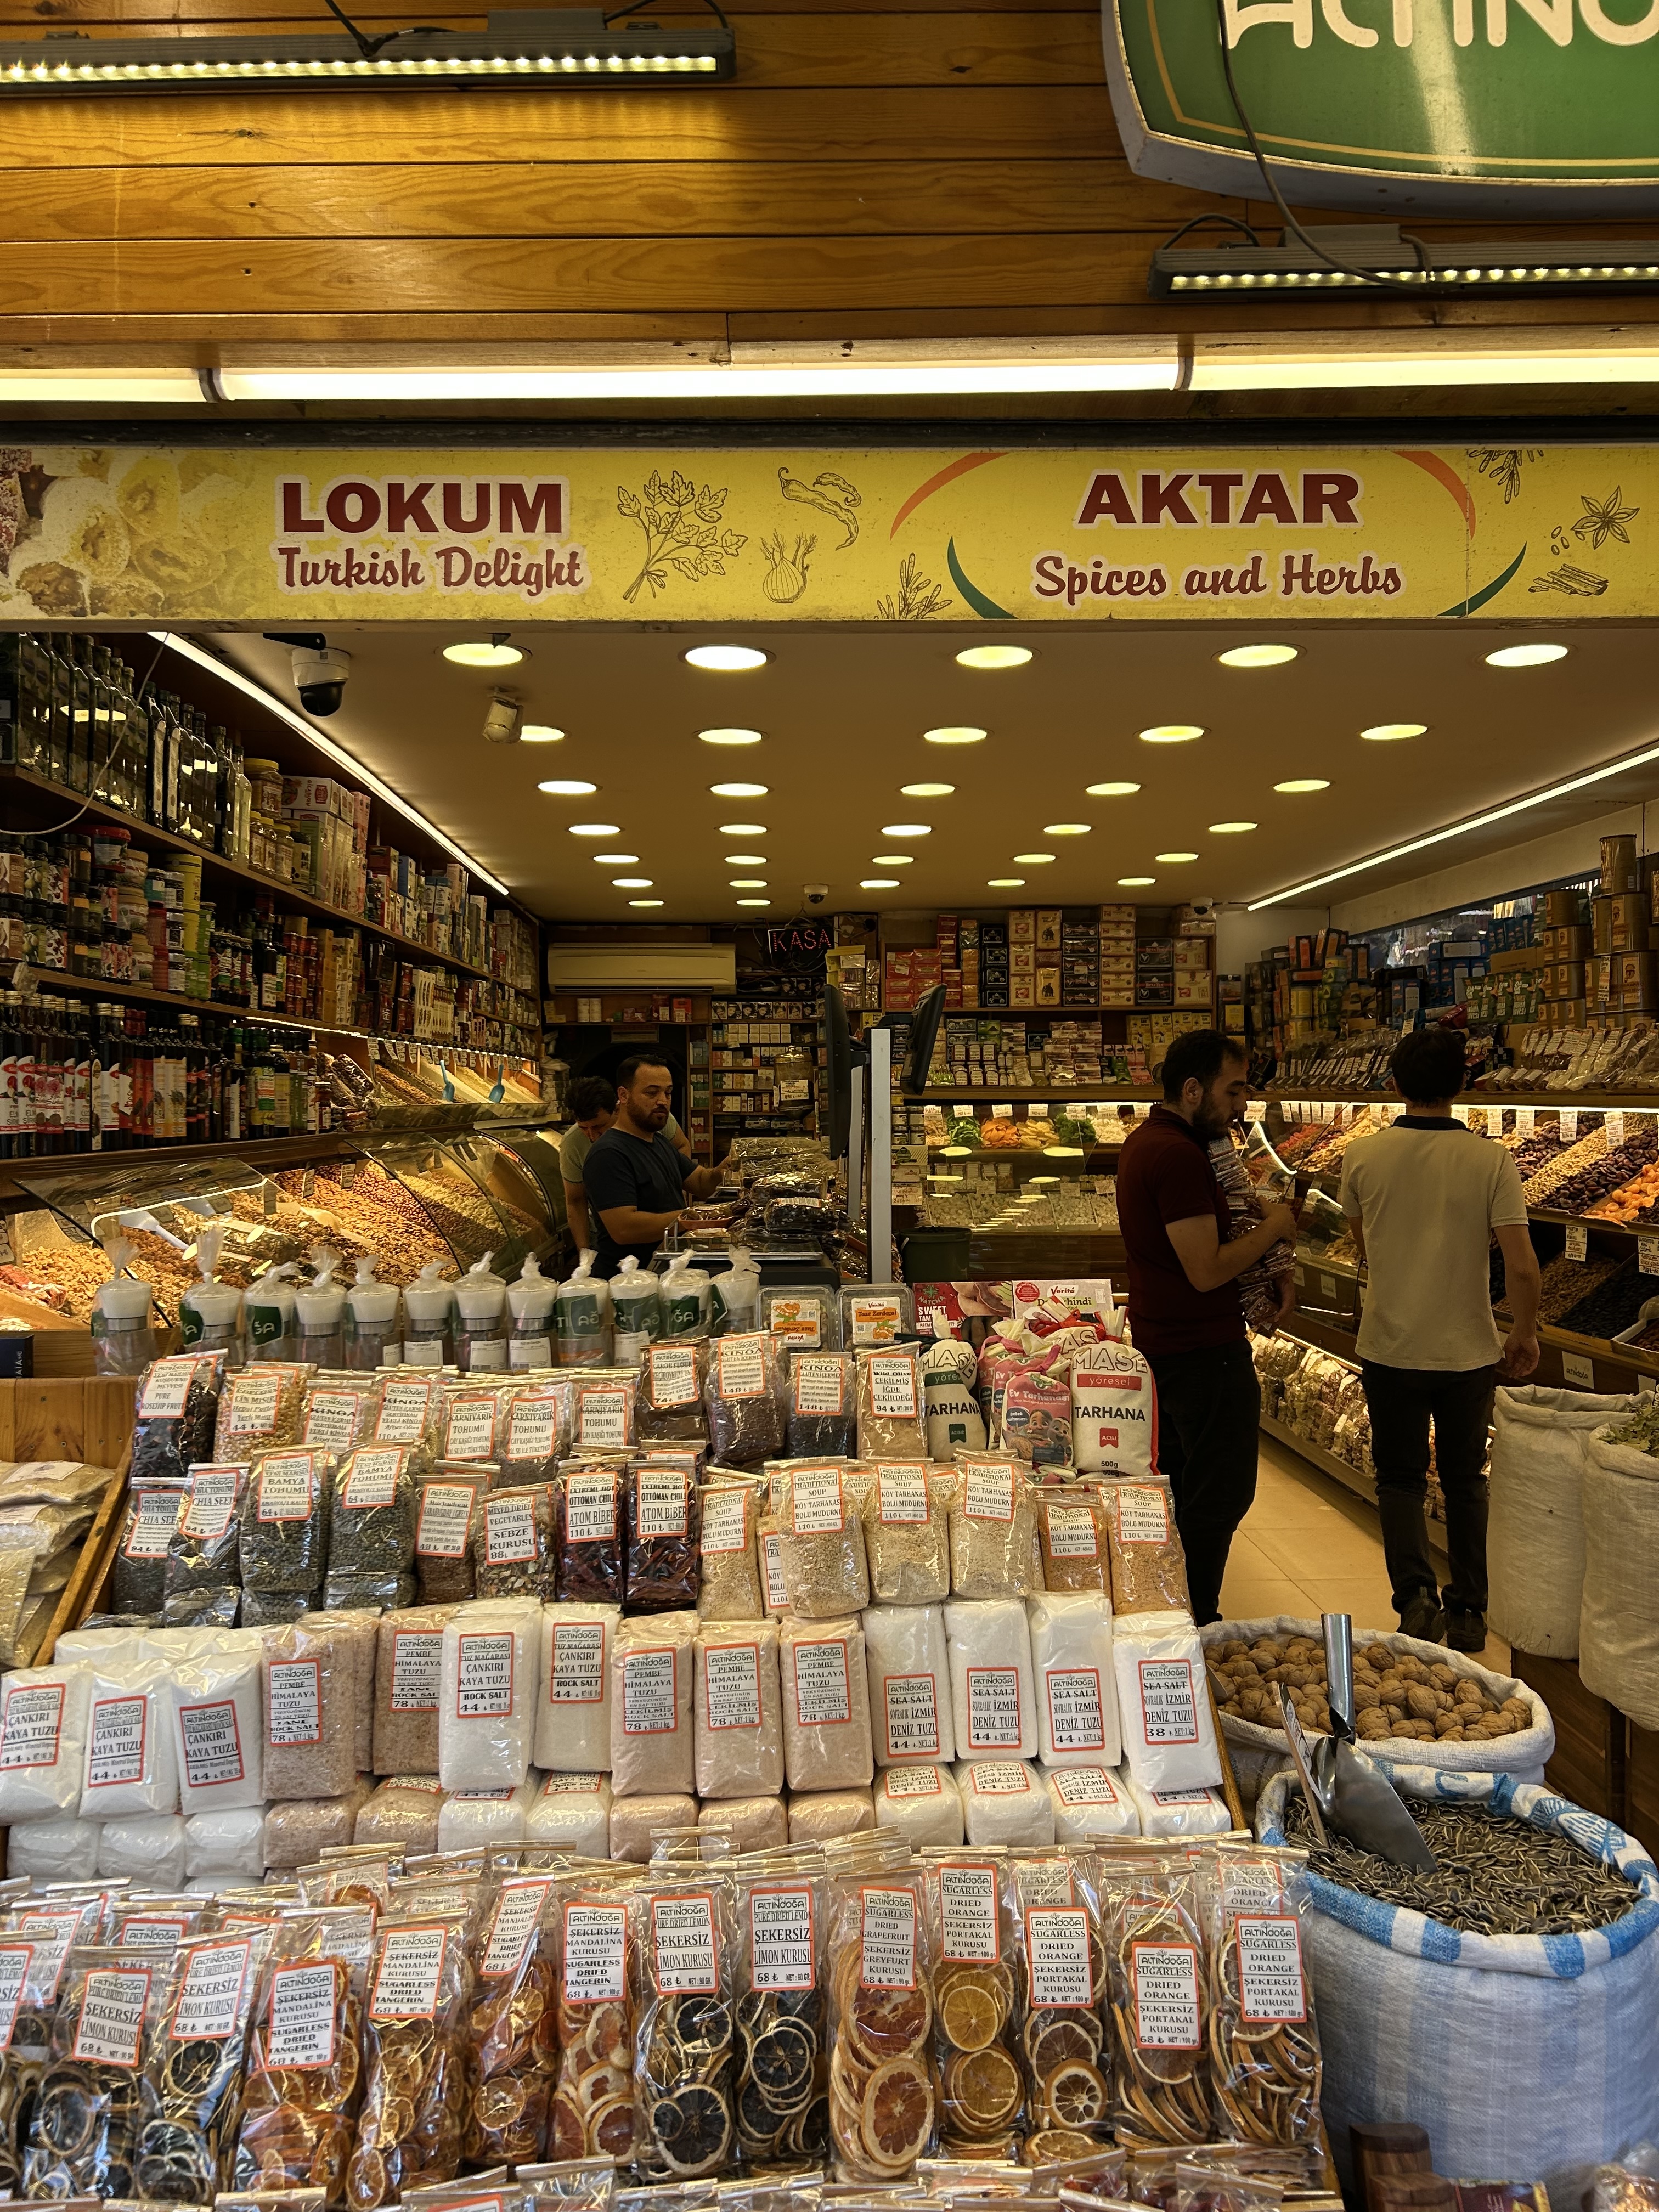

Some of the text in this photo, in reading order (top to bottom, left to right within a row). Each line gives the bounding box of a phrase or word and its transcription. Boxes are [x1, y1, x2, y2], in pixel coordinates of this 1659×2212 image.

[1078, 474, 1360, 524] AKTAR
[283, 482, 562, 533] LOKUM
[278, 545, 584, 597] Turkish Delight
[1035, 554, 1401, 606] Spices and Herbs
[773, 929, 832, 951] KASA
[1073, 1348, 1148, 1373] MASE
[1089, 1376, 1130, 1386] yöresel
[1009, 1389, 1019, 1398] Ev
[925, 1402, 981, 1417] TARHANA
[1075, 1406, 1146, 1421] TARHANA
[514, 1425, 546, 1434] TOHUMU
[1101, 1460, 1118, 1469] 500g
[641, 1492, 668, 1502] OTTOMAN
[488, 1505, 510, 1515] MIXED
[641, 1504, 687, 1520] ATOM BİBER
[490, 1514, 533, 1525] VEGETABLES
[642, 1524, 656, 1532] 110
[494, 1528, 529, 1539] SEBZE
[490, 1538, 535, 1550] KURUSU
[560, 1652, 595, 1662] ÇANKIRI
[466, 1663, 504, 1675] ÇANKIRI
[553, 1664, 601, 1673] KAYA TUZU
[798, 1671, 844, 1679] HİMALAYA
[460, 1675, 510, 1686] KAYA TUZU
[1143, 1682, 1161, 1690] SEA
[489, 1691, 508, 1699] SALT
[1074, 1689, 1097, 1697] SALT
[1166, 1694, 1191, 1703] İZMİR
[460, 1703, 480, 1712] 44
[1075, 1701, 1100, 1711] İZMİR
[1146, 1708, 1193, 1722] DENİZ TUZU
[1055, 1716, 1102, 1730] DENİZ TUZU
[1147, 1728, 1165, 1736] 38
[188, 1730, 226, 1746] ÇANKIRI
[1056, 1735, 1074, 1743] 44
[186, 1742, 238, 1758] KAYA TUZU
[943, 1886, 993, 1895] SUGARLESS
[754, 1911, 812, 1922] PURE DRIED LEMON
[865, 1908, 913, 1918] SUGARLESS
[949, 1909, 990, 1917] ORANGE
[654, 1917, 710, 1928] PURE DRIED LEMON
[874, 1921, 898, 1929] DRIED
[571, 1927, 619, 1938] ŞEKERSİZ
[755, 1926, 810, 1944] ŞEKERSİZ
[861, 1931, 910, 1940] GRAPEFRUIT
[566, 1938, 622, 1947] MANDALİNA
[656, 1932, 709, 1949] ŞEKERSİZ
[754, 1947, 812, 1965] LİMON KURUSU
[864, 1946, 911, 1956] ŞEKERSİZ
[566, 1959, 620, 1967] SUGARLESS
[655, 1952, 712, 1970] LİMON KURUSU
[863, 1955, 910, 1965] GREYFURT
[869, 1966, 905, 1974] KURUSU
[1034, 1965, 1086, 1973] ŞEKERSİZ
[1136, 1967, 1193, 1976] SUGARLESS
[566, 1977, 611, 1986] TANGERIN
[661, 1977, 672, 1987] 68
[758, 1973, 769, 1982] 68
[183, 1977, 238, 1996] ŞEKERSİZ
[567, 1991, 580, 1999] 68
[1144, 1991, 1190, 2000] ORANGE
[205, 1997, 235, 2013] KURUSU
[1139, 2005, 1194, 2013] ŞEKERSİZ
[1142, 2015, 1194, 2023] PORTAKAL
